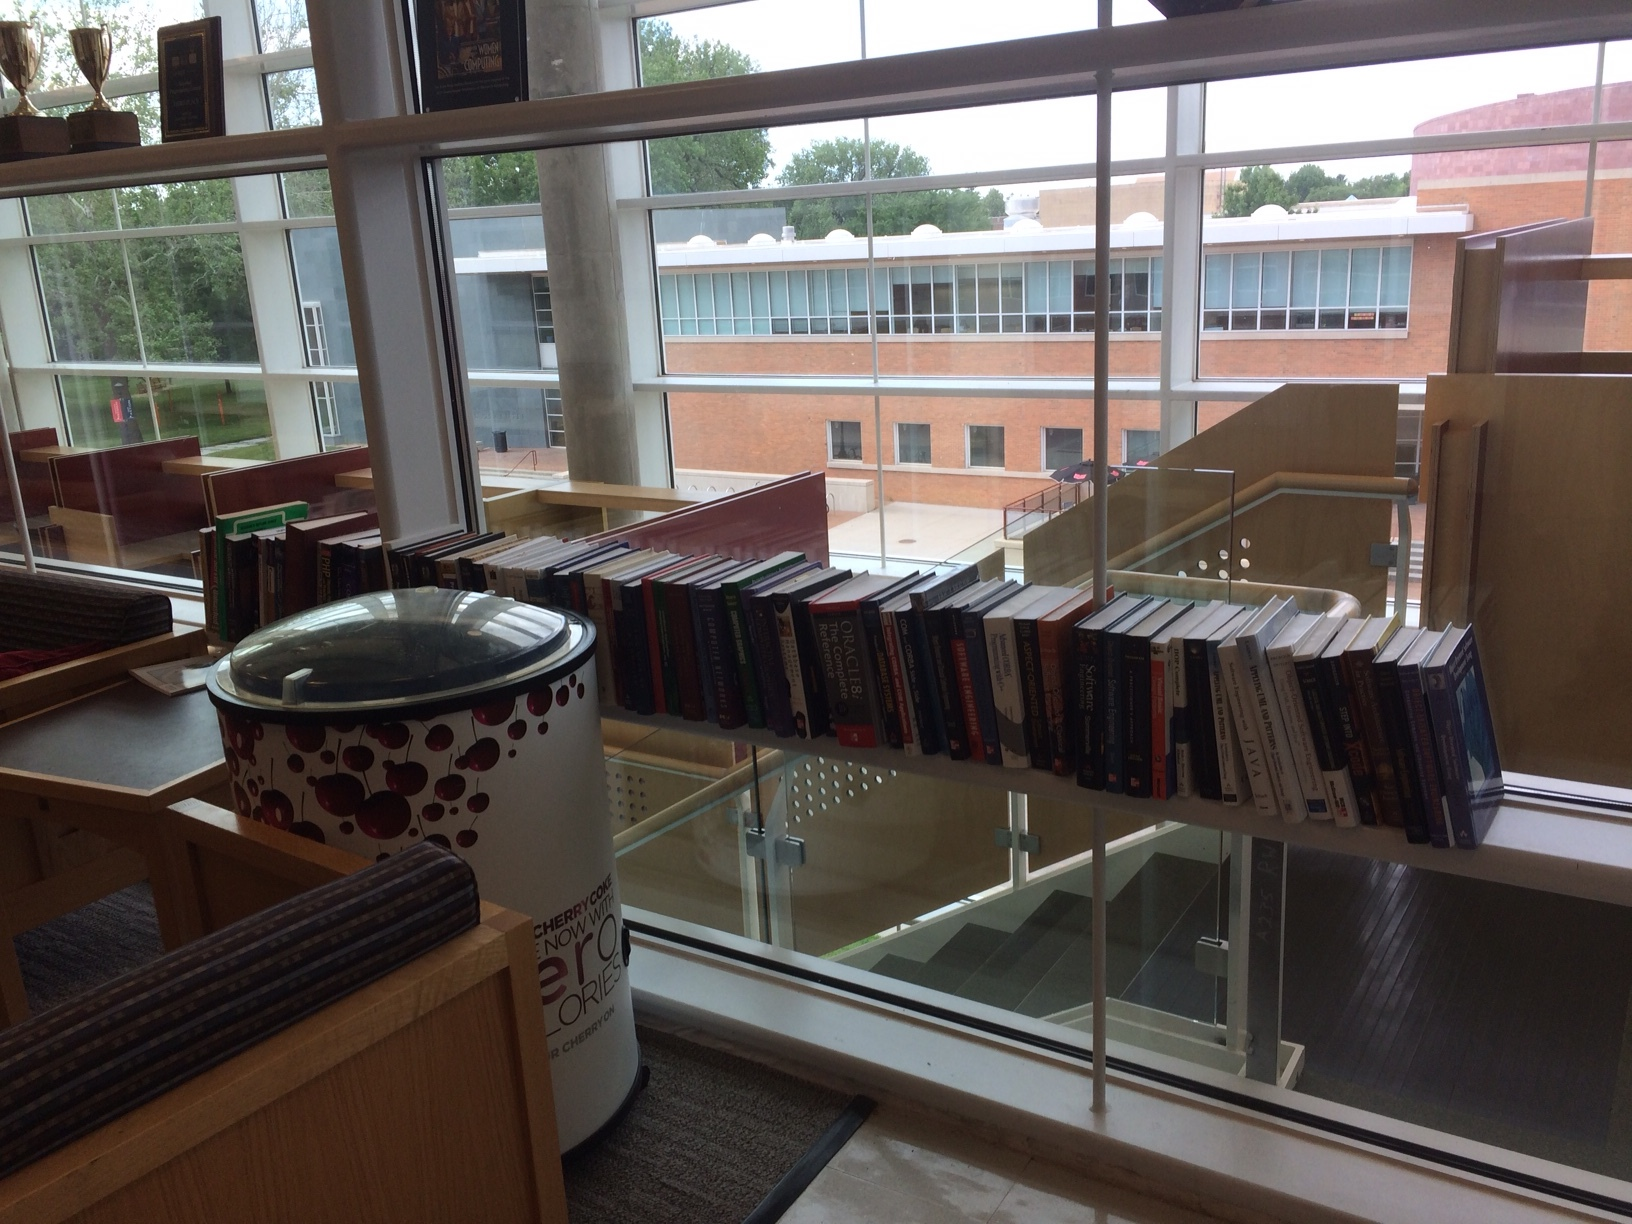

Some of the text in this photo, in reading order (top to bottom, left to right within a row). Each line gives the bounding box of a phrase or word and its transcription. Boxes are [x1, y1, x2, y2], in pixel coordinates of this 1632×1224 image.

[322, 556, 330, 578] PHP
[706, 616, 721, 661] COMPUTER
[730, 610, 746, 665] COMPUTER GRAPHICS
[818, 623, 836, 679] Reference
[899, 618, 908, 636] COM
[904, 644, 915, 669] CORBA
[829, 622, 849, 700] The Complete
[876, 651, 889, 684] DATABASE
[1022, 640, 1040, 717] ASPECT-ORIENTED
[1228, 662, 1239, 686] Software
[1249, 665, 1264, 693] APPLYING
[882, 684, 895, 713] SYSTEMS
[955, 642, 980, 736] SOFTWARE ENGINEERING
[1084, 664, 1096, 712] Software
[1107, 679, 1116, 707] Software
[1232, 686, 1246, 720] Engineering
[1256, 692, 1268, 709] UML
[1283, 669, 1303, 723] Object-Oriented
[1107, 709, 1116, 745] Engineering
[1241, 719, 1250, 731] with
[1261, 708, 1270, 720] AND
[1338, 706, 1350, 723] STEP
[1343, 723, 1354, 739] INTO
[1264, 720, 1278, 751] PATTERNS
[1297, 723, 1310, 752] Software
[1243, 738, 1263, 778] JAVA
[1303, 753, 1319, 792] Engineering
[1343, 740, 1366, 778] Xcode
[534, 872, 612, 939] CHERRY COKE
[544, 915, 587, 956] NOW
[588, 888, 615, 926] WITH
[562, 1016, 603, 1053] CHERRY
[603, 1005, 615, 1022] ON
